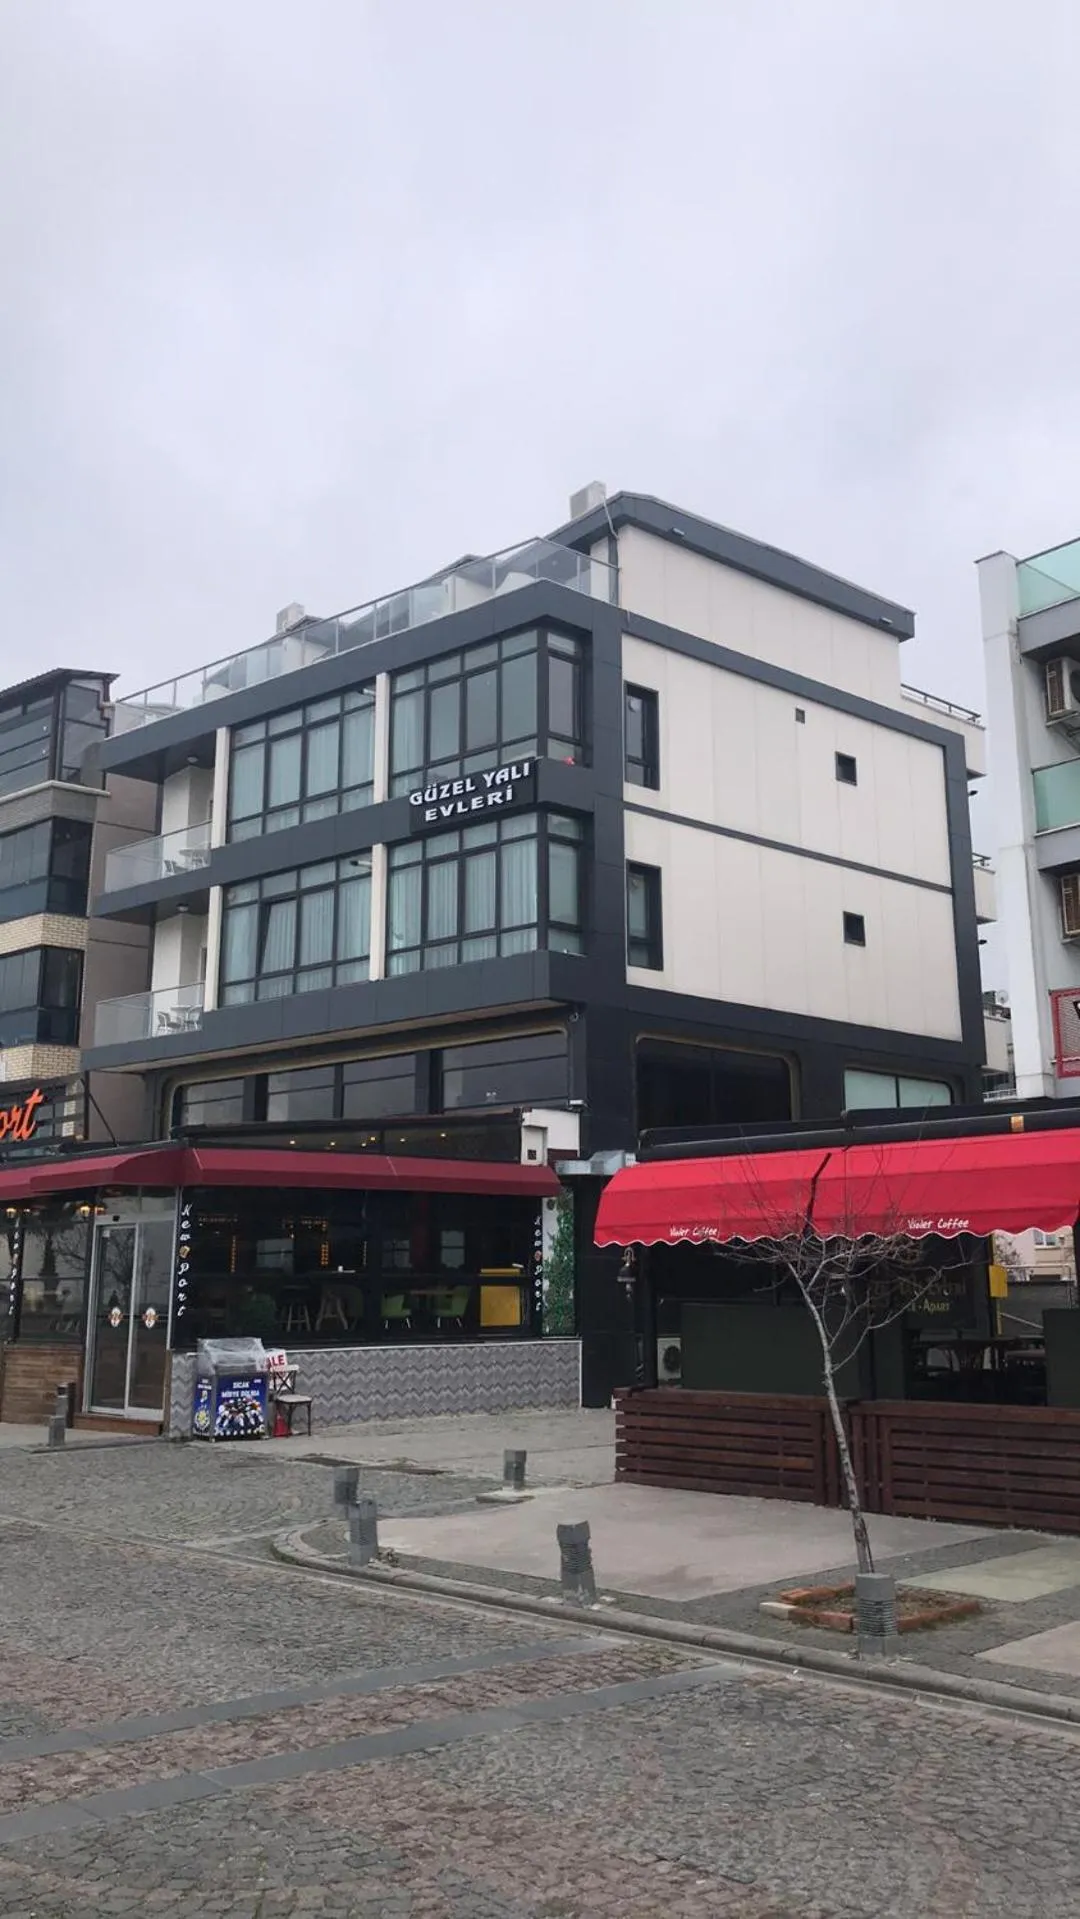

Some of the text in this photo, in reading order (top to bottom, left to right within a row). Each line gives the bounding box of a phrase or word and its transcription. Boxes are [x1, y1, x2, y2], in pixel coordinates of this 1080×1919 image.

[409, 762, 530, 806] GÜZEL YALI
[425, 785, 513, 822] EVLERİ
[937, 1217, 970, 1230] Coffee
